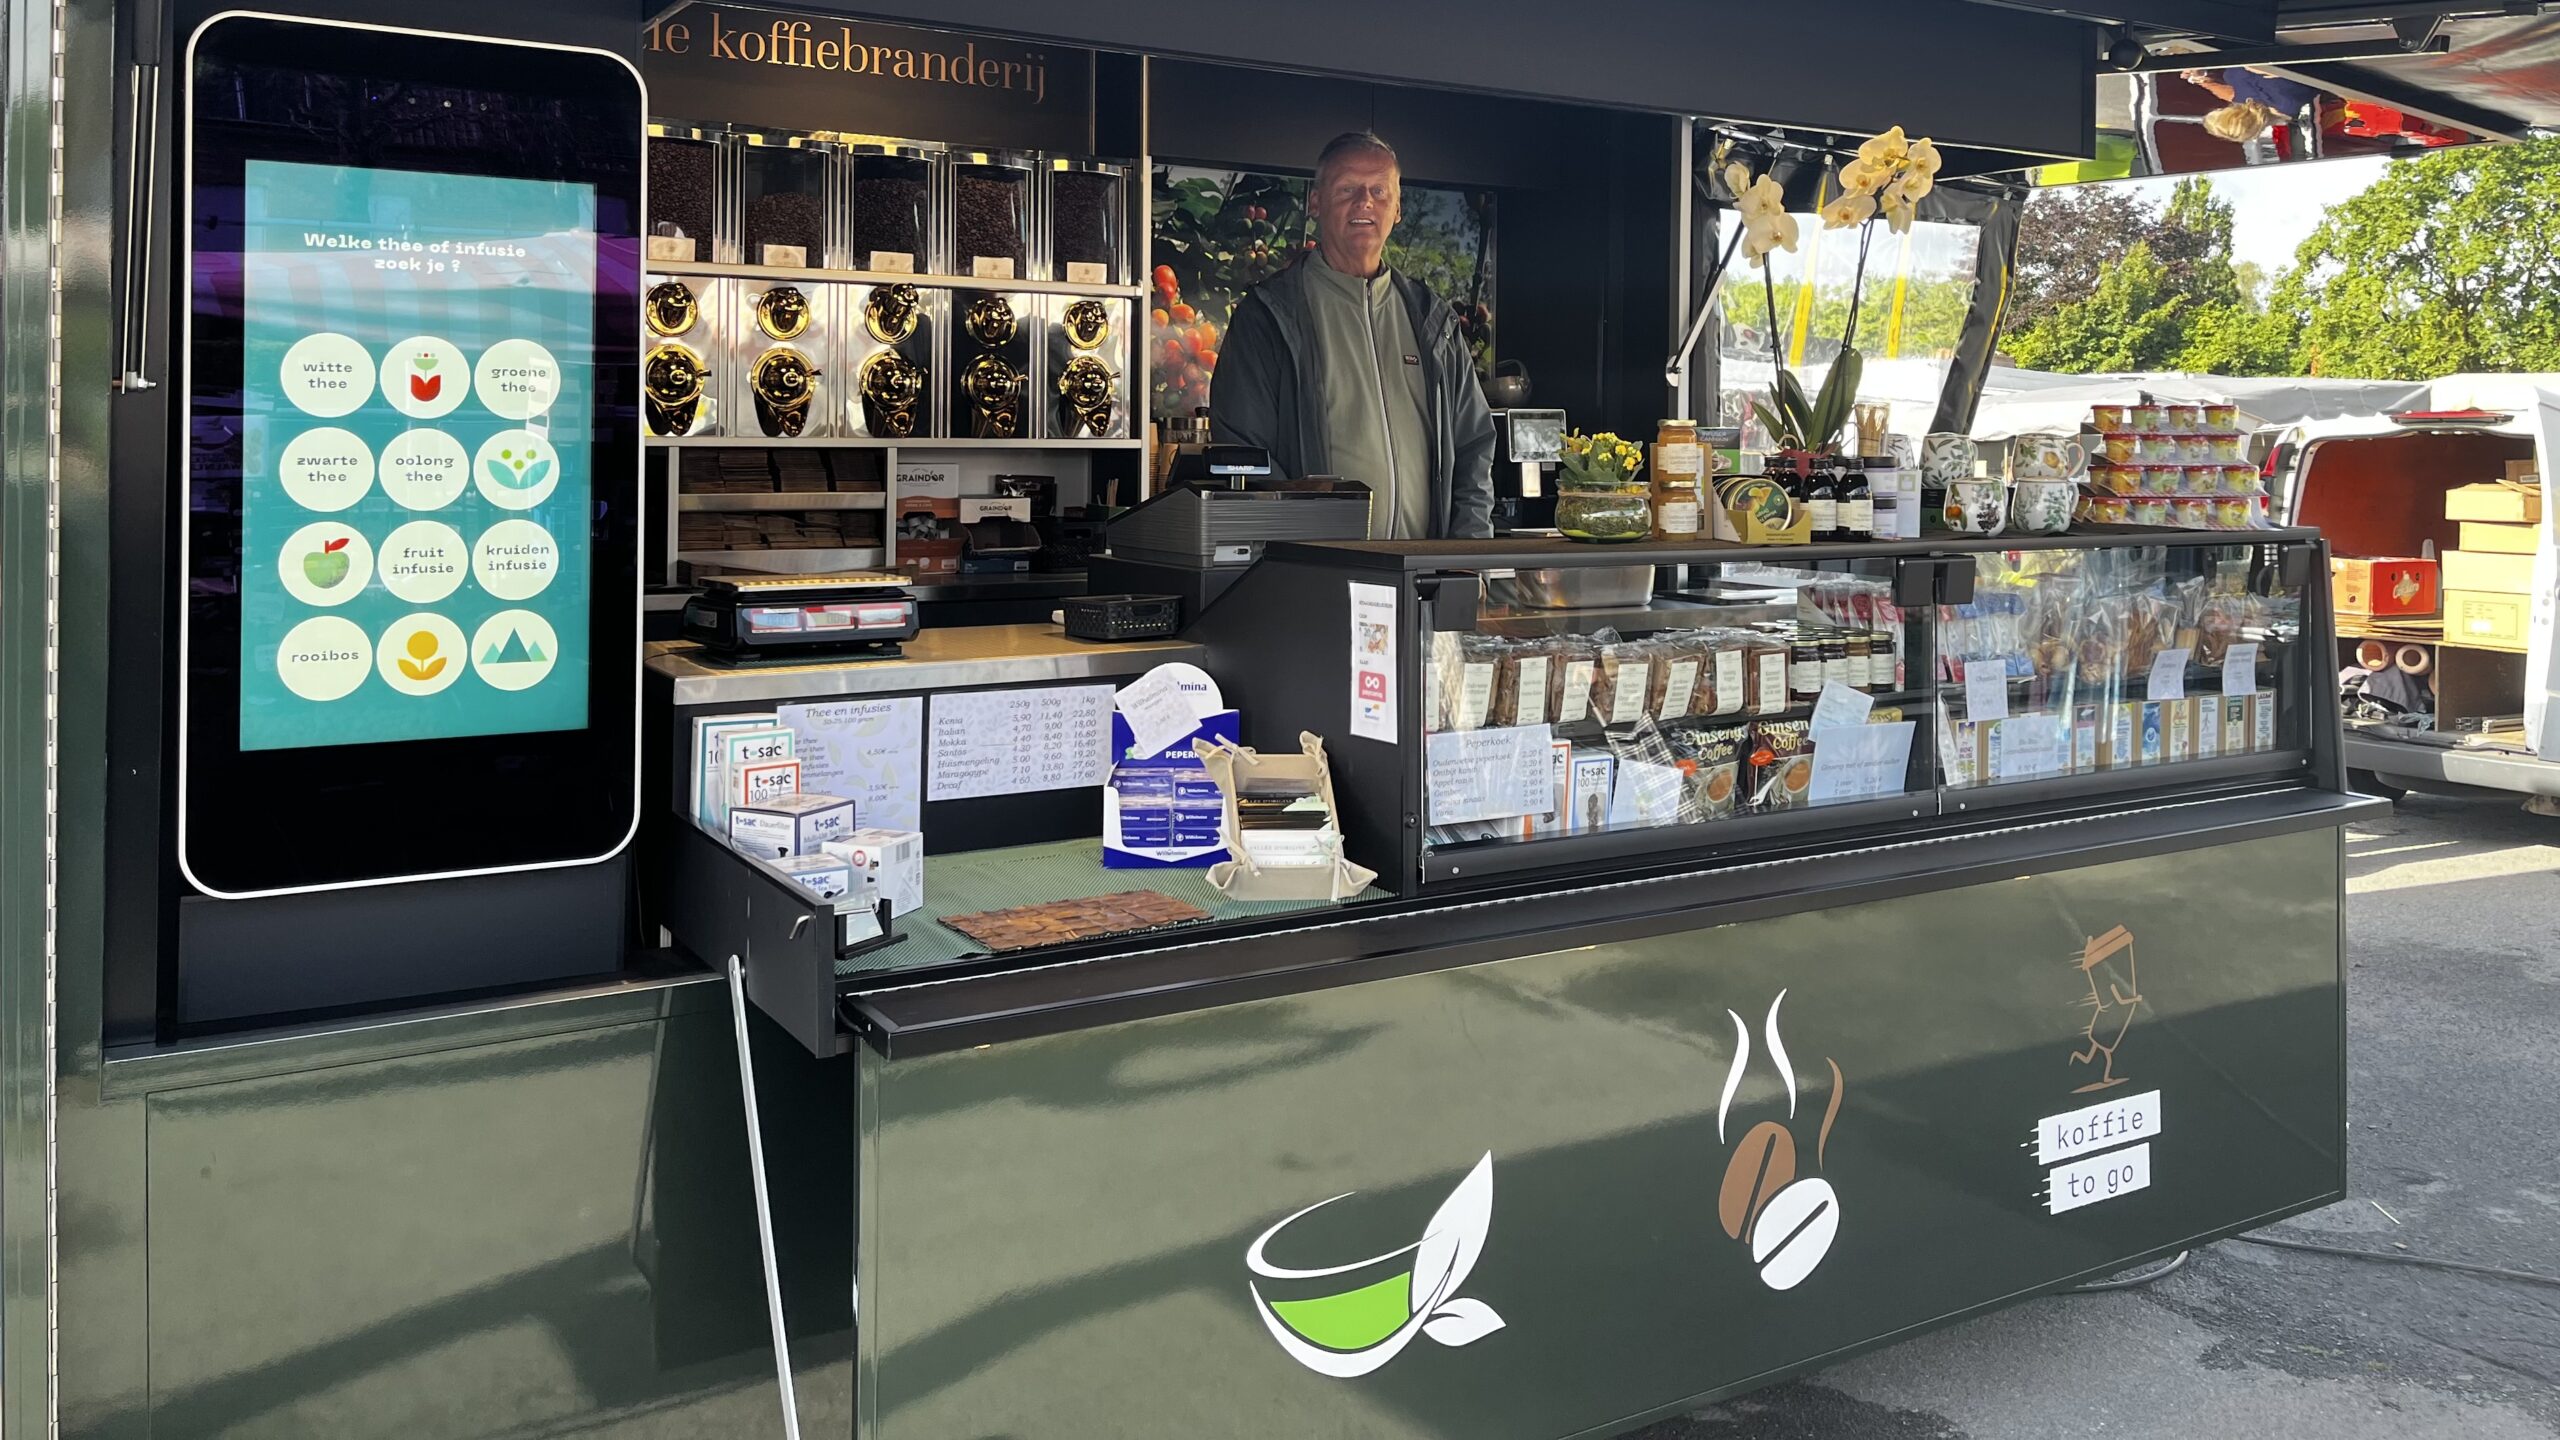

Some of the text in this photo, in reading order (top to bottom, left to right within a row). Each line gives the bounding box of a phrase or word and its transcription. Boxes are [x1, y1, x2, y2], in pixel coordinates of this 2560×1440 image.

[709, 12, 1046, 104] koffiebranderij
[304, 232, 526, 258] Welke thee of infusie
[374, 258, 460, 273] zoek je ?
[303, 362, 353, 373] witte
[491, 368, 546, 379] groene
[309, 377, 347, 389] thee
[502, 382, 536, 392] thee
[297, 455, 358, 466] zwarte
[396, 455, 454, 469] oolong
[308, 471, 347, 483] thee
[406, 470, 443, 482] thee
[404, 546, 444, 558] fruit
[486, 544, 550, 555] kruiden
[393, 562, 454, 574] infusie
[488, 559, 547, 571] infusie
[292, 650, 359, 662] rooibos
[1010, 701, 1030, 709] 250g
[1082, 697, 1095, 705] 1kg
[806, 704, 892, 718] Thee en infusies
[938, 728, 965, 736] Italian
[1758, 719, 1810, 736] Ginsen
[1466, 736, 1511, 749] Peperkoek
[1772, 736, 1809, 751] Coffee
[742, 745, 782, 759] t-sac
[1698, 744, 1733, 762] Coffee
[1581, 766, 1607, 777] t-sac
[754, 774, 791, 788] t-sac
[937, 780, 963, 790] Decaf
[750, 788, 768, 801] 100
[735, 815, 756, 827] t-sac
[815, 815, 840, 832] t-sac
[800, 875, 830, 886] t-sac
[2057, 1108, 2143, 1150] koffie
[2068, 1164, 2134, 1198] to go
